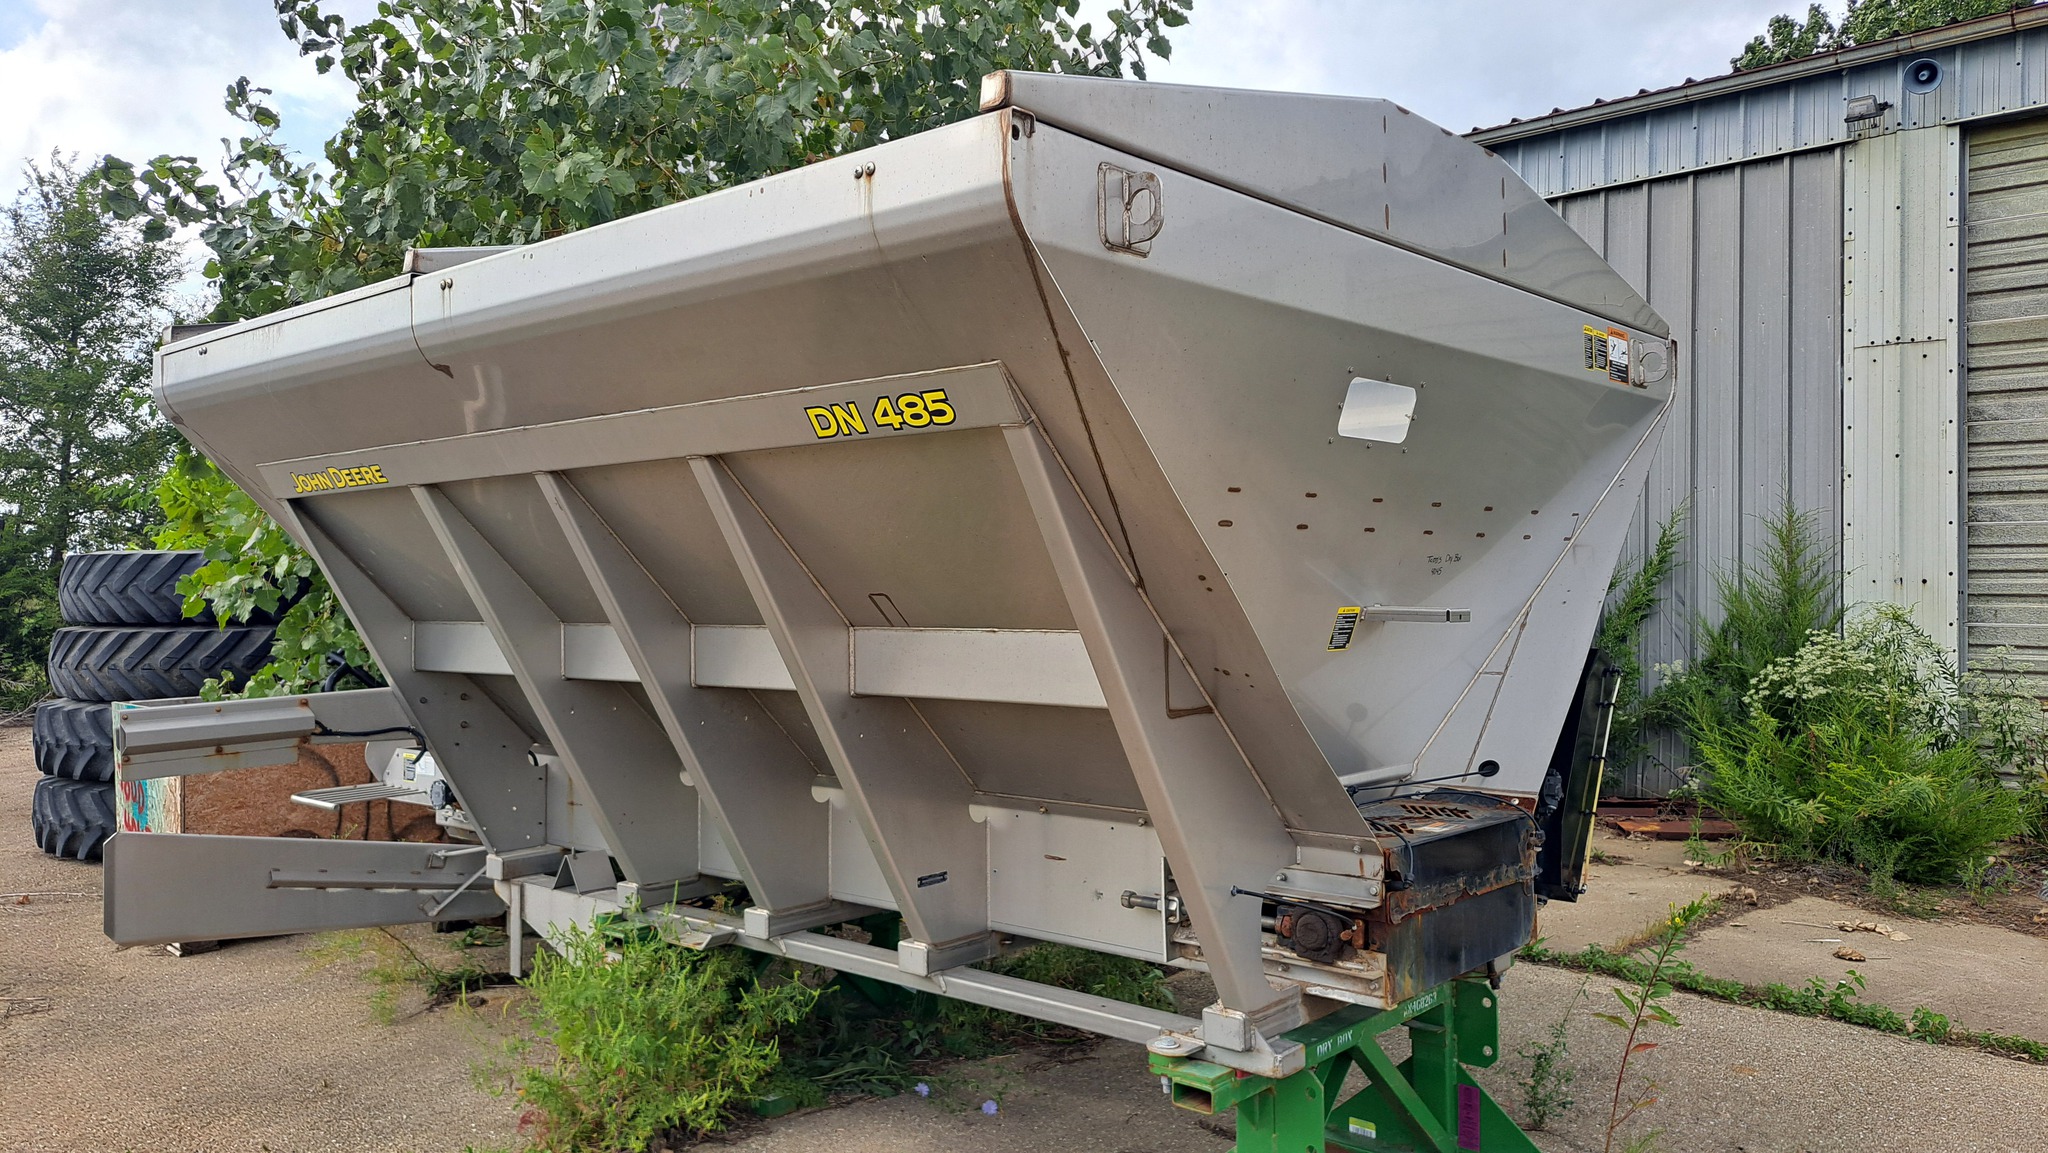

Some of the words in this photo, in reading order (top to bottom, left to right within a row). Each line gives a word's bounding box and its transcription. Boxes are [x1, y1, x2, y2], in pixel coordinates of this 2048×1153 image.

[804, 401, 869, 439] DN
[872, 388, 956, 431] 485
[290, 471, 335, 493] JOHN
[326, 463, 389, 488] DEERE
[1316, 1038, 1333, 1057] DRY
